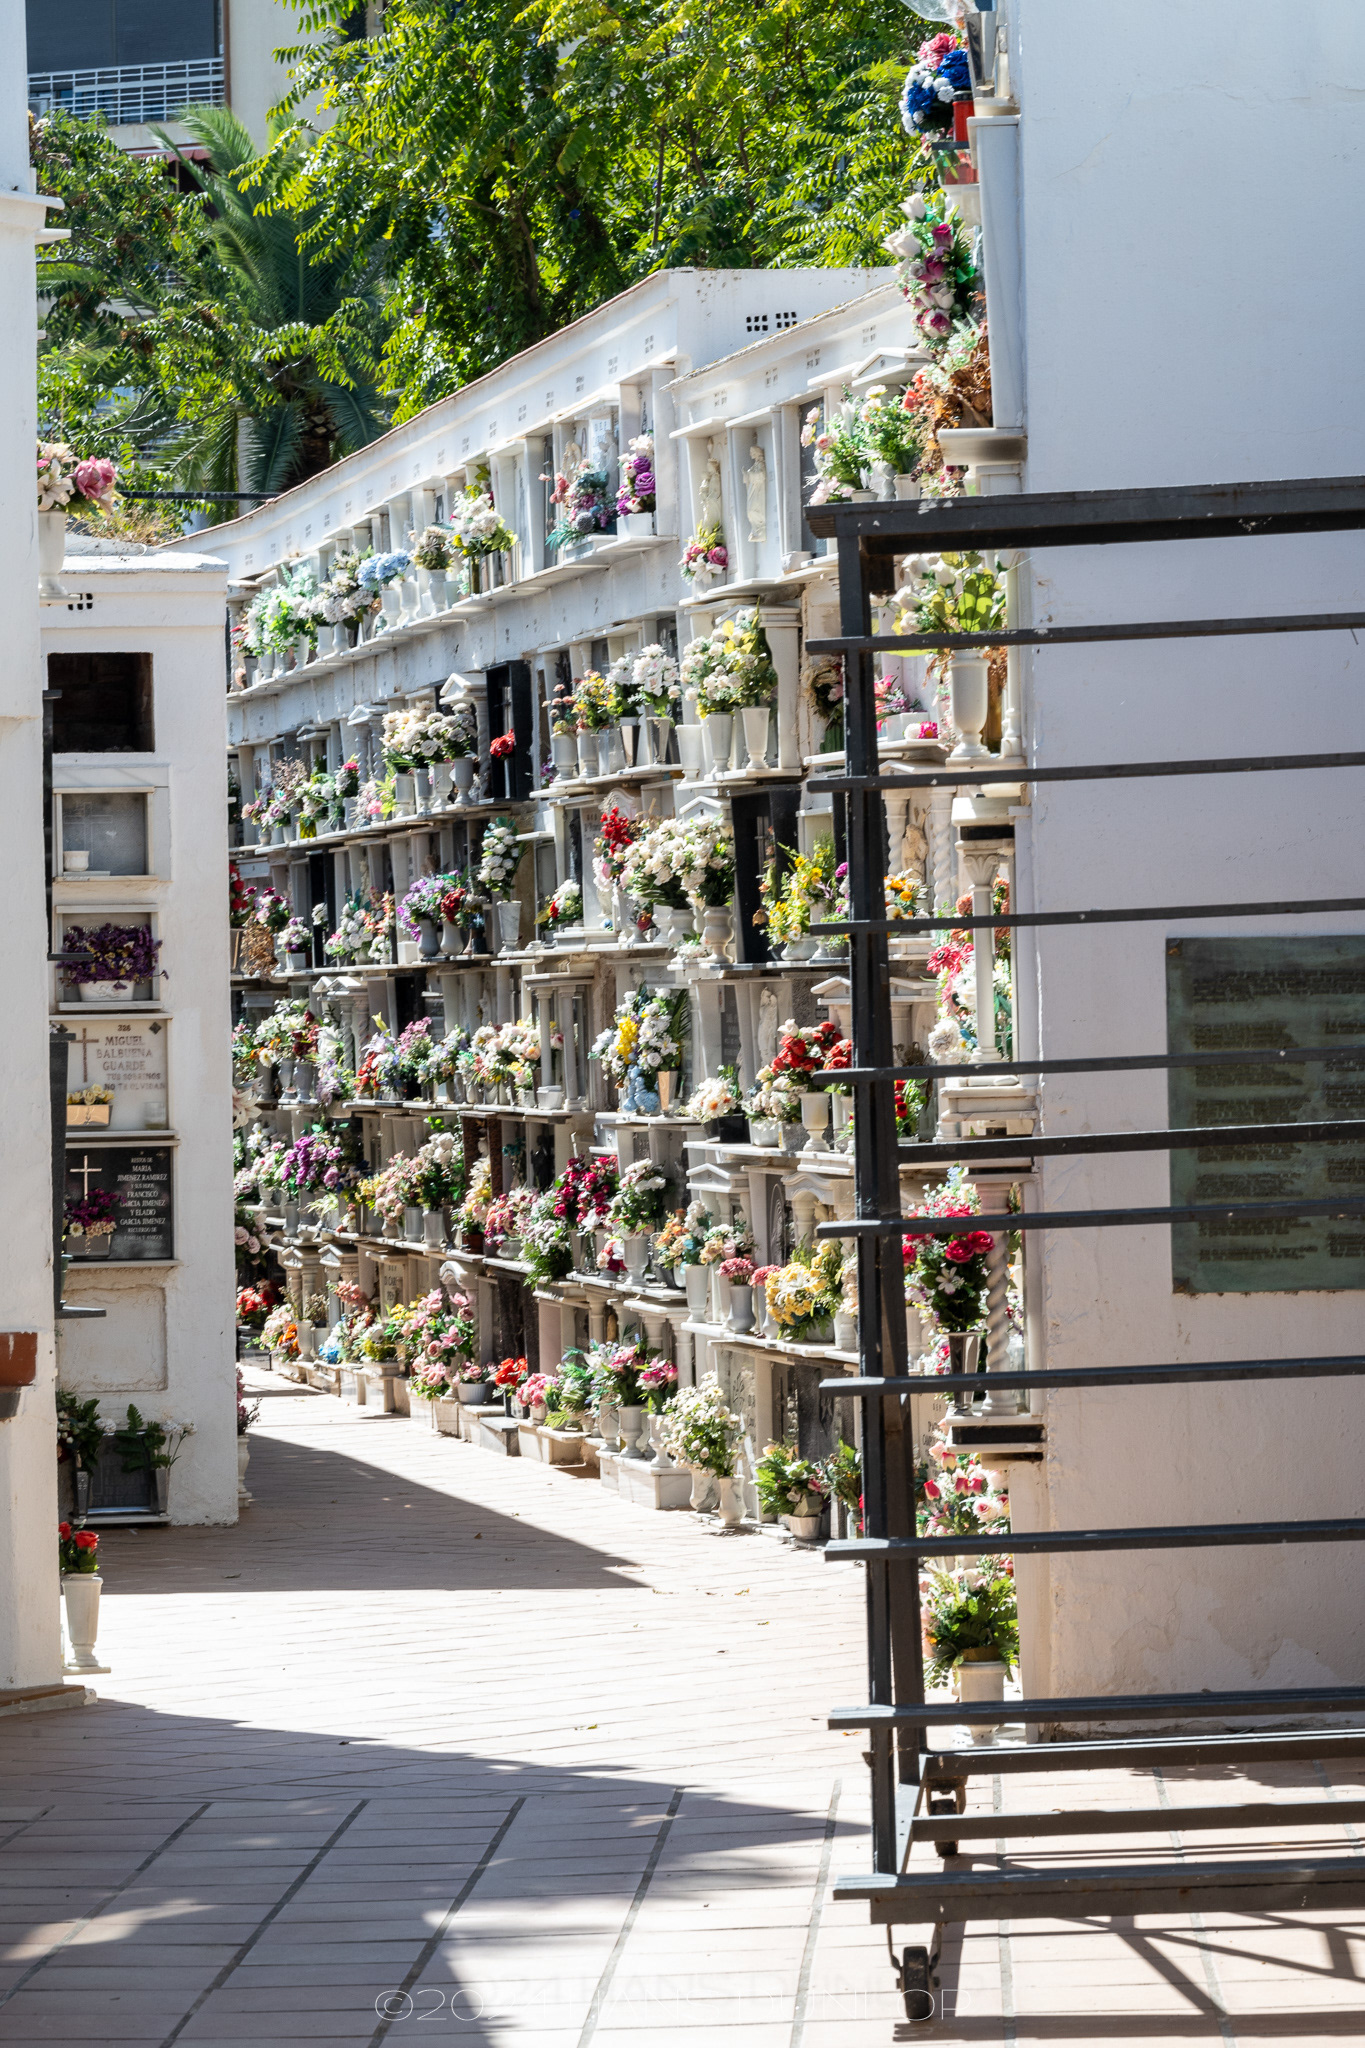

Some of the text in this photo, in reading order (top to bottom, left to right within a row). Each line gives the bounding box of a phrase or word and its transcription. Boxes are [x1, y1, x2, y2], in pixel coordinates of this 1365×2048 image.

[105, 1035, 145, 1046] MIGUEL
[104, 1083, 116, 1091] NO
[127, 1190, 158, 1198] FRANCISCO
